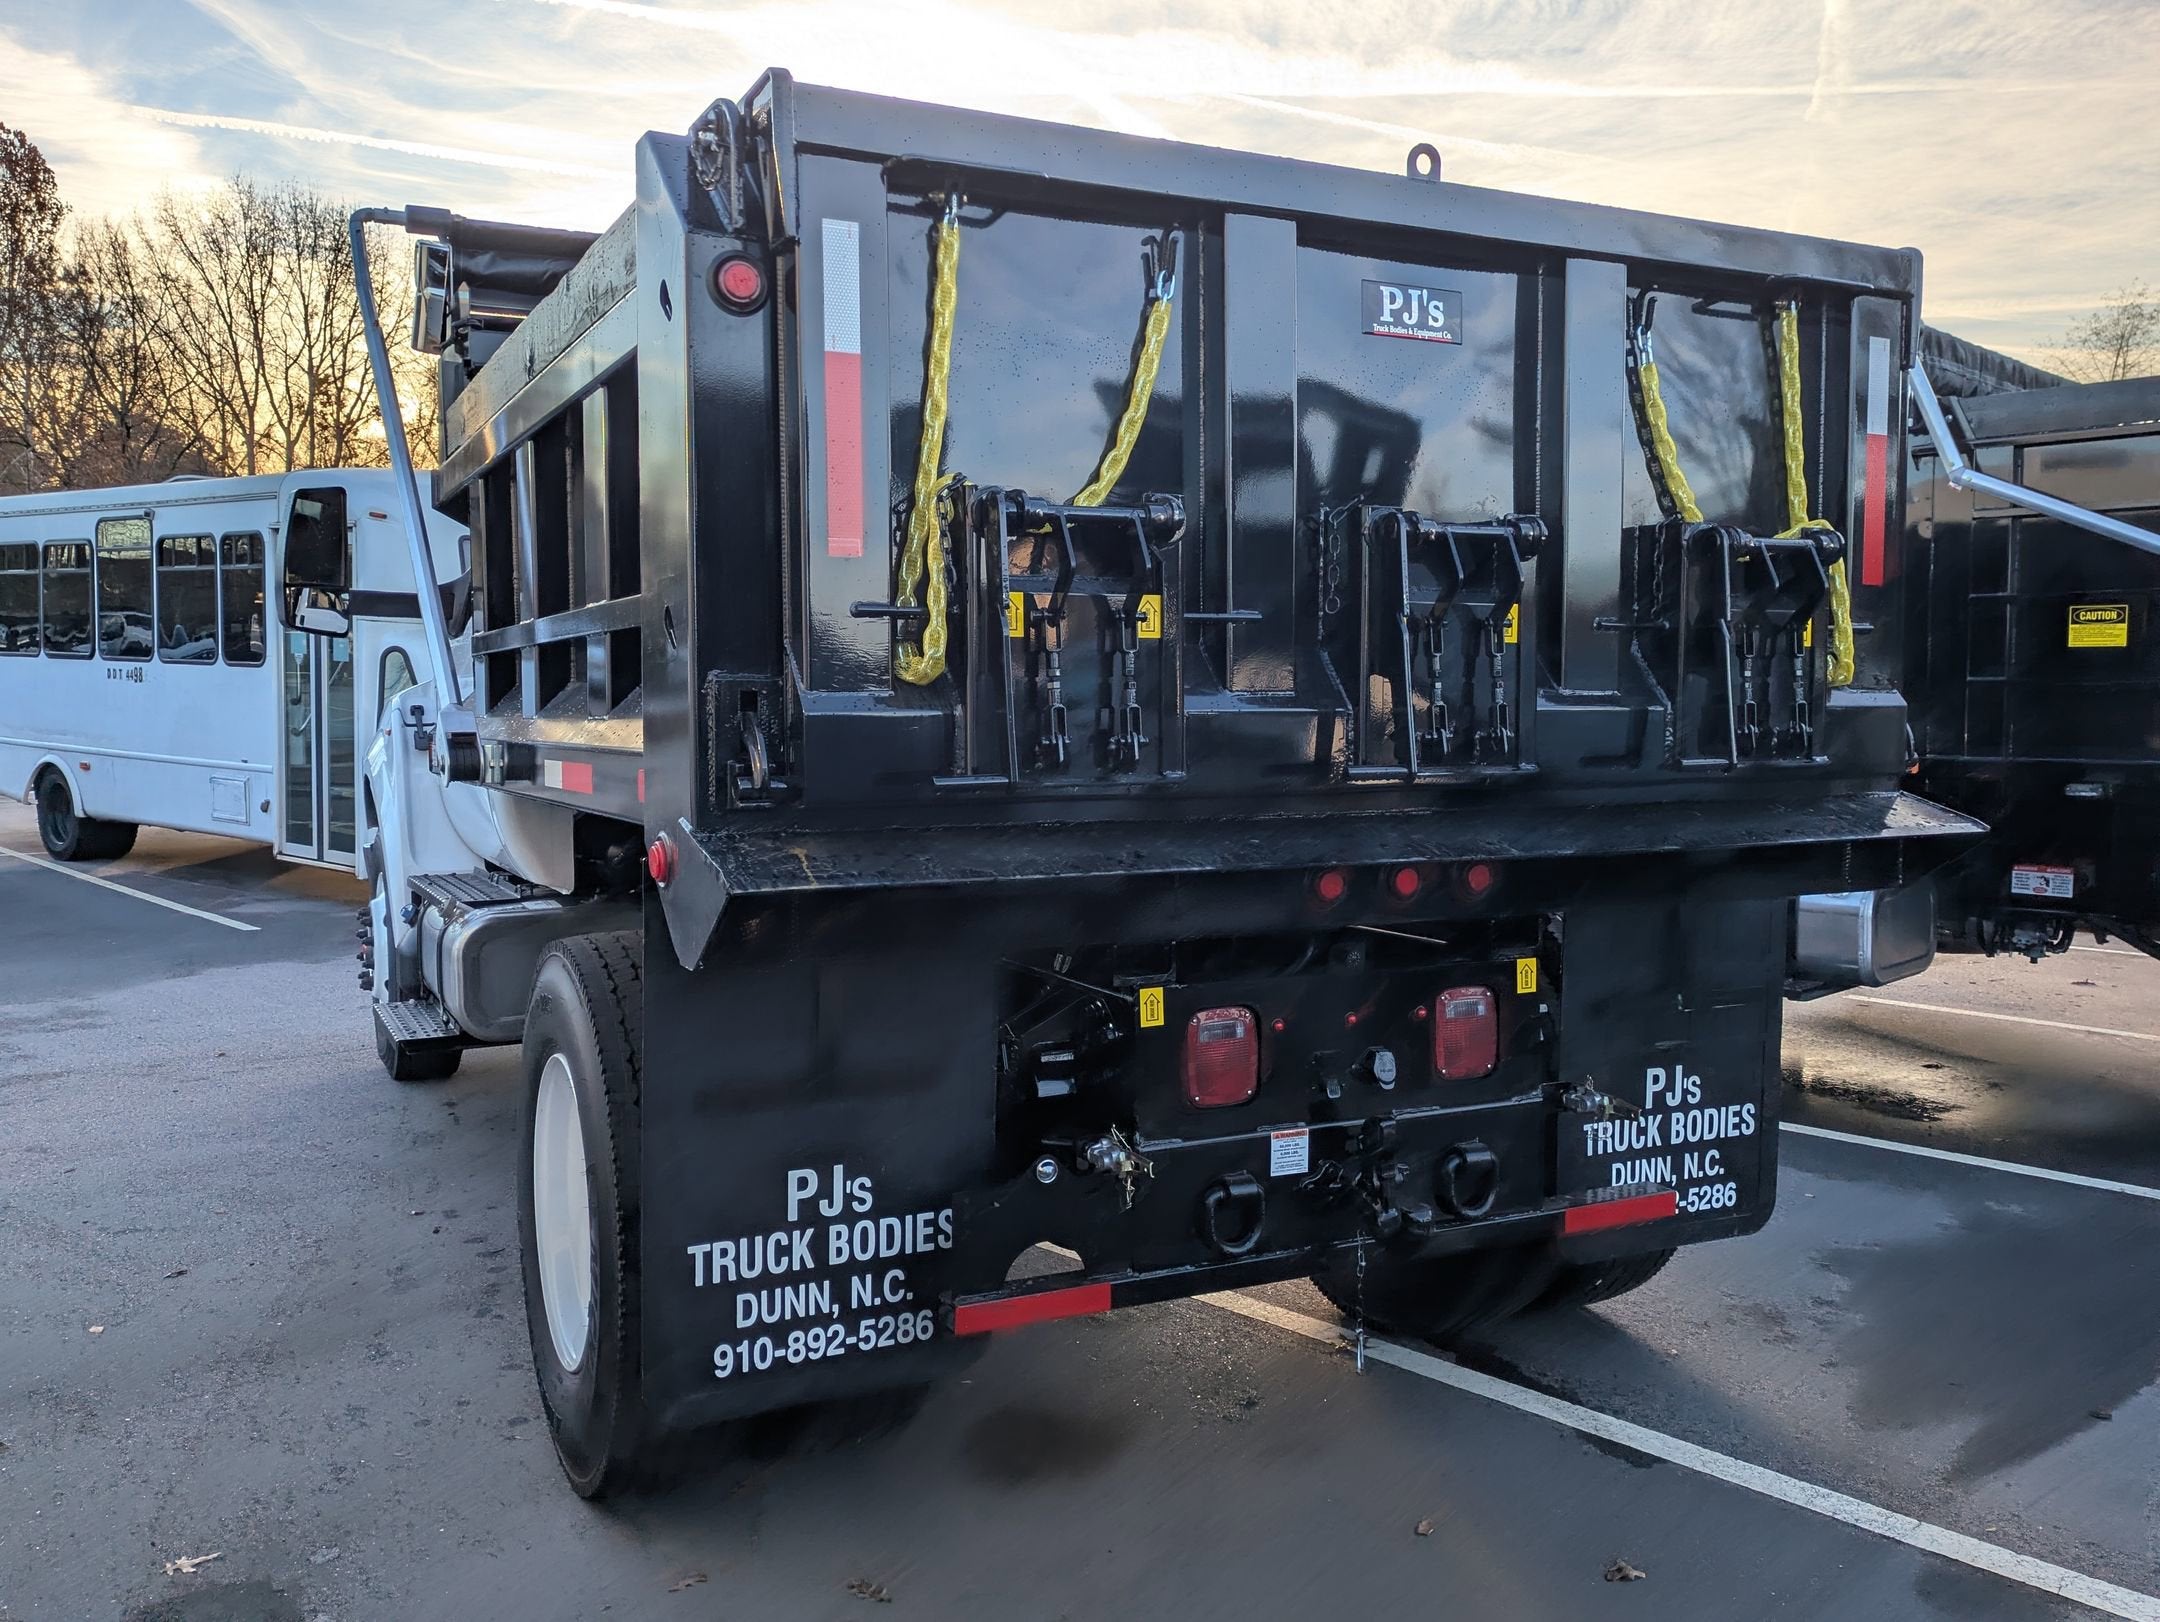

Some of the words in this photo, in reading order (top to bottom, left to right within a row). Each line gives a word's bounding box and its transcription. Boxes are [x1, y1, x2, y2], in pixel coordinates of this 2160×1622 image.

[1380, 285, 1444, 327] PJ's
[1373, 323, 1390, 333] Truck
[1389, 325, 1408, 335] Bodies
[1414, 327, 1443, 340] Equipment
[2079, 611, 2118, 621] CAUTION
[126, 667, 143, 683] 4498
[1645, 1065, 1701, 1109] PJ's
[1583, 1114, 1662, 1157] TRUCK
[1670, 1103, 1756, 1145] BODIES
[1611, 1156, 1677, 1187] DUNN,
[1684, 1149, 1725, 1180] N.C.
[787, 1164, 873, 1222] PJ's
[687, 1228, 815, 1287] TRUCK
[828, 1208, 953, 1265] BODIES
[736, 1280, 840, 1329] DUNN,
[851, 1269, 914, 1309] N.C.
[713, 1309, 934, 1378] 910-892-5286
